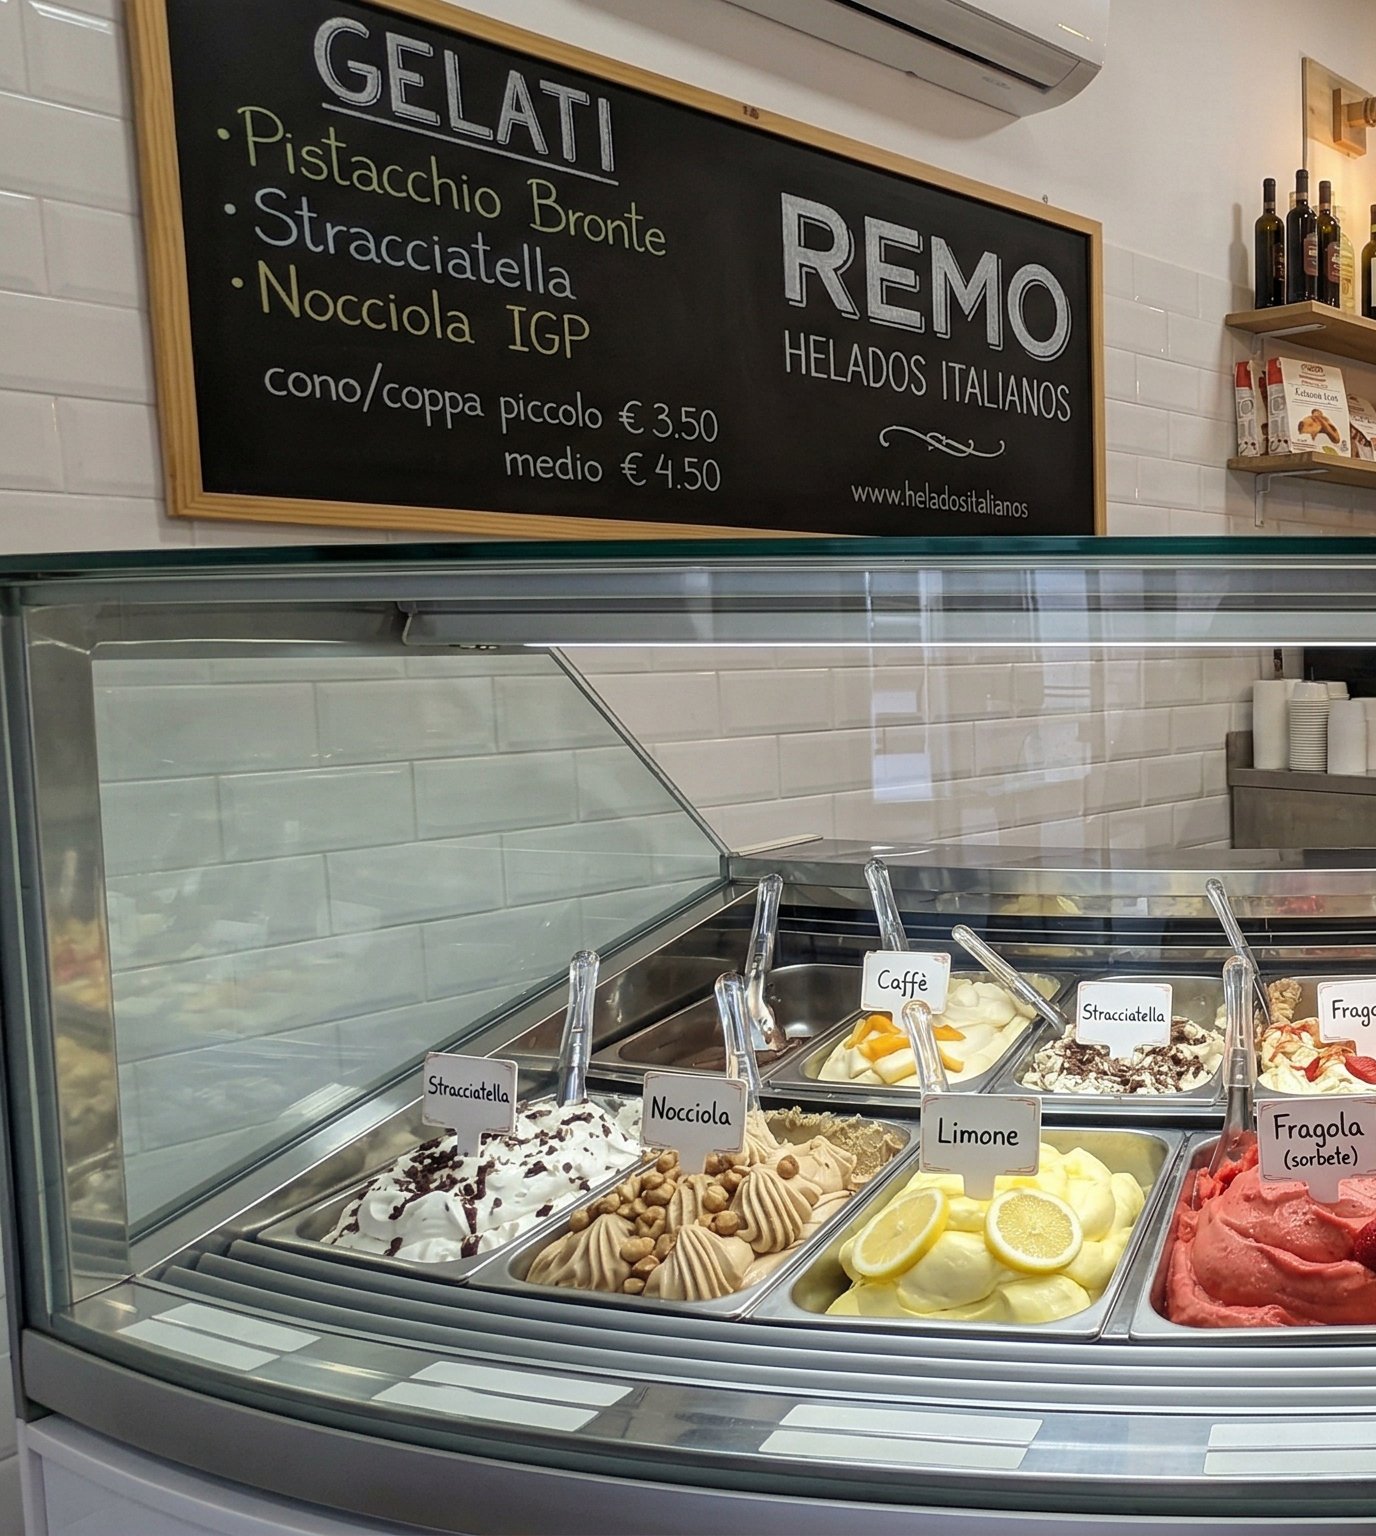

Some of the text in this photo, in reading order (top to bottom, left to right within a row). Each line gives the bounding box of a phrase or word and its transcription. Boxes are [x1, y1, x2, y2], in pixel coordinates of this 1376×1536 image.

[313, 15, 616, 174] GELATI
[237, 105, 667, 257] Pistacchio Bronte
[254, 186, 577, 300] Stracciatella
[781, 192, 1072, 362] REMO
[257, 259, 591, 359] Nocciola IGP
[784, 329, 1071, 422] HELADOS ITALIANOS
[263, 361, 485, 430] cono/coppa
[499, 391, 603, 435] piccolo
[504, 446, 603, 483] medio
[851, 480, 1029, 519] www.heladositalianos
[877, 969, 929, 998] Caffè
[1081, 1003, 1166, 1023] Stracciatella
[427, 1074, 510, 1104] Stracciatella
[650, 1094, 731, 1126] Nocciola
[937, 1117, 1019, 1146] Limone
[1273, 1111, 1365, 1148] Fragola
[1283, 1145, 1358, 1170] (sorbete)
